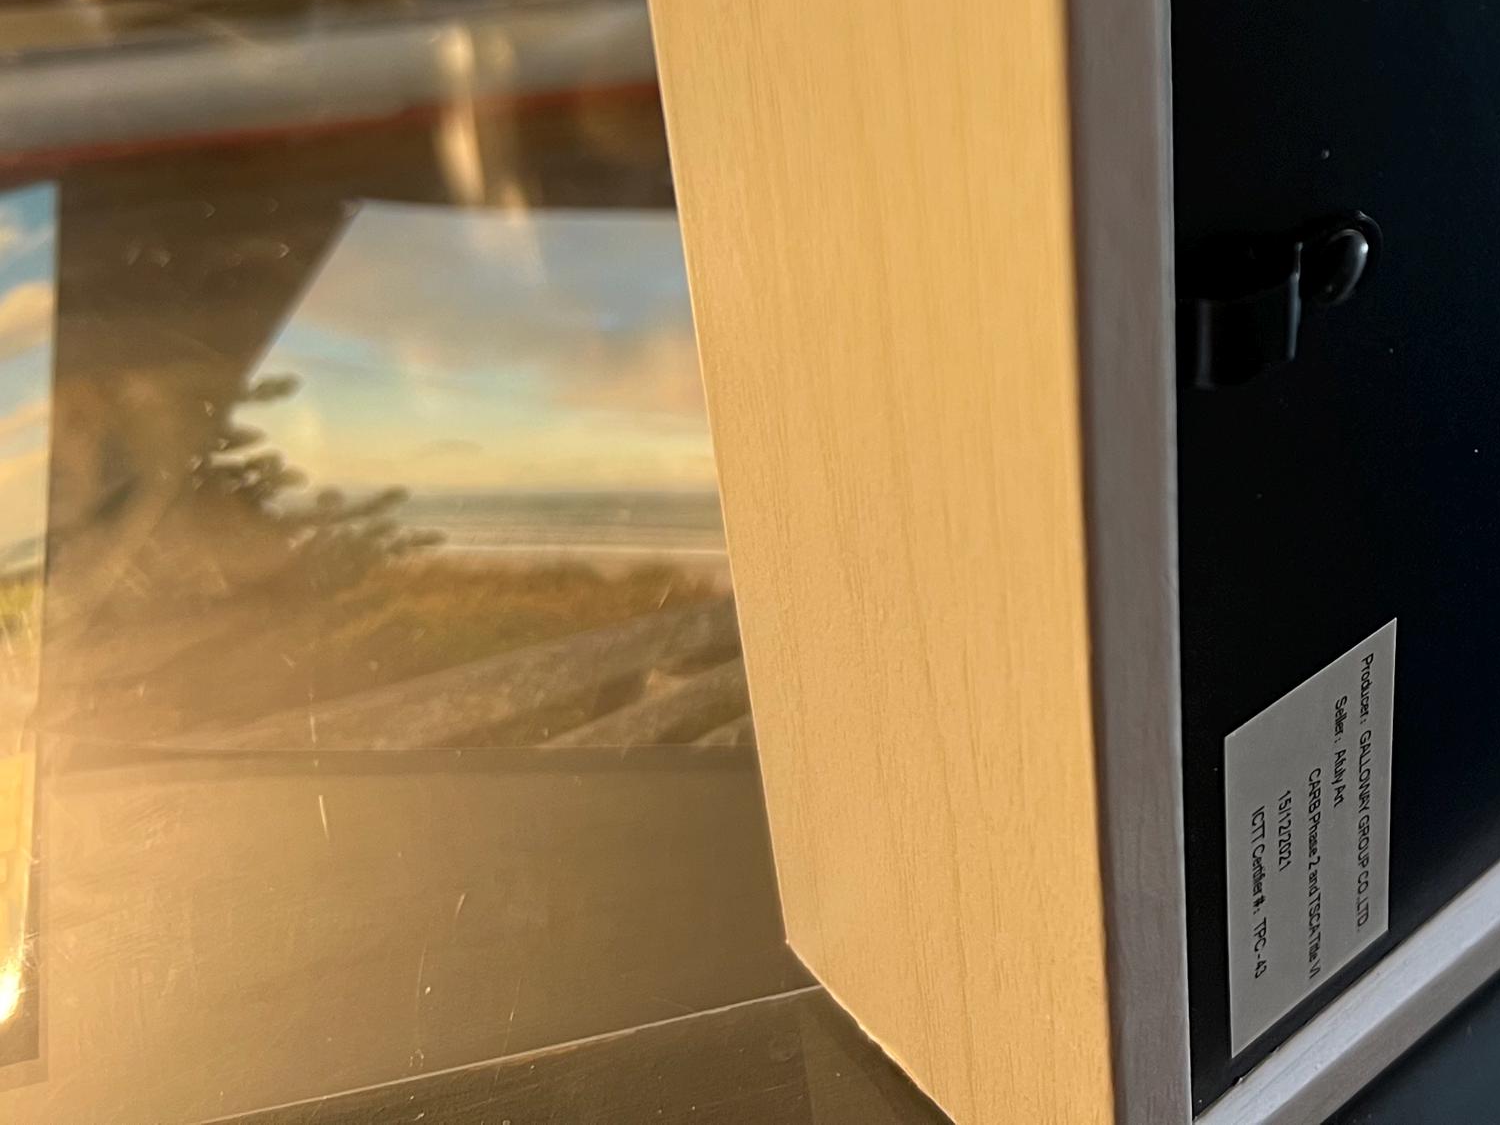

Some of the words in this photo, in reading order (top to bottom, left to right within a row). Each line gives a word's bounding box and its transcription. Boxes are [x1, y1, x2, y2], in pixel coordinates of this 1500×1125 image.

[1330, 748, 1347, 785] Afuly
[1357, 728, 1372, 814] GALLOWAY
[1307, 766, 1322, 815] CARB
[1332, 783, 1347, 809] Art
[1250, 804, 1266, 844] ICTT
[1277, 789, 1292, 872] 15/12/2021
[1307, 810, 1322, 858] Phase
[1356, 813, 1370, 869] GROUP
[1251, 842, 1266, 897] Certifier
[1307, 868, 1321, 898] and
[1252, 915, 1267, 953] TPC
[1307, 891, 1321, 938] TSCA
[1307, 930, 1322, 963] Title
[1253, 958, 1268, 980] 43
[1307, 957, 1321, 980] VI
